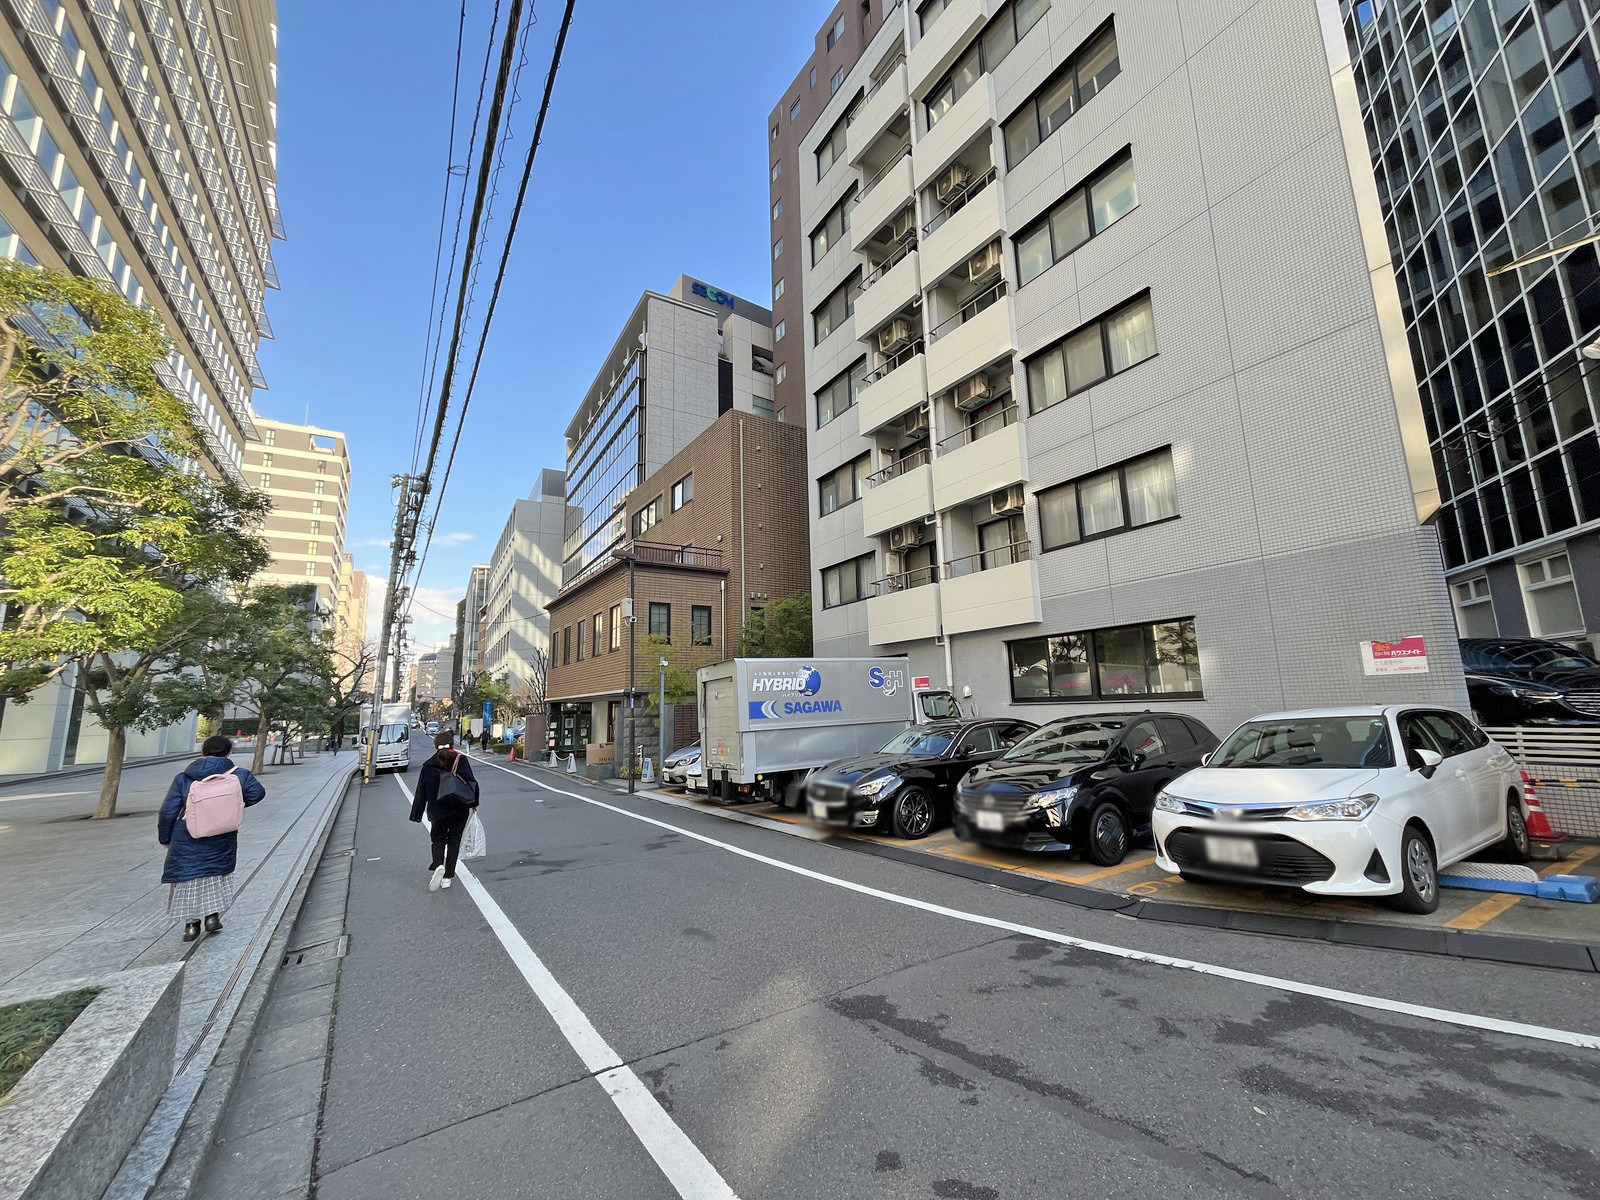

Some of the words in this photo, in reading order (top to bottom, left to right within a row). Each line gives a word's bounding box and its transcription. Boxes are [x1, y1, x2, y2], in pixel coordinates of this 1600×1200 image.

[691, 281, 735, 309] SECOM
[752, 677, 807, 692] HYBRID
[784, 700, 843, 715] SAGAWA
